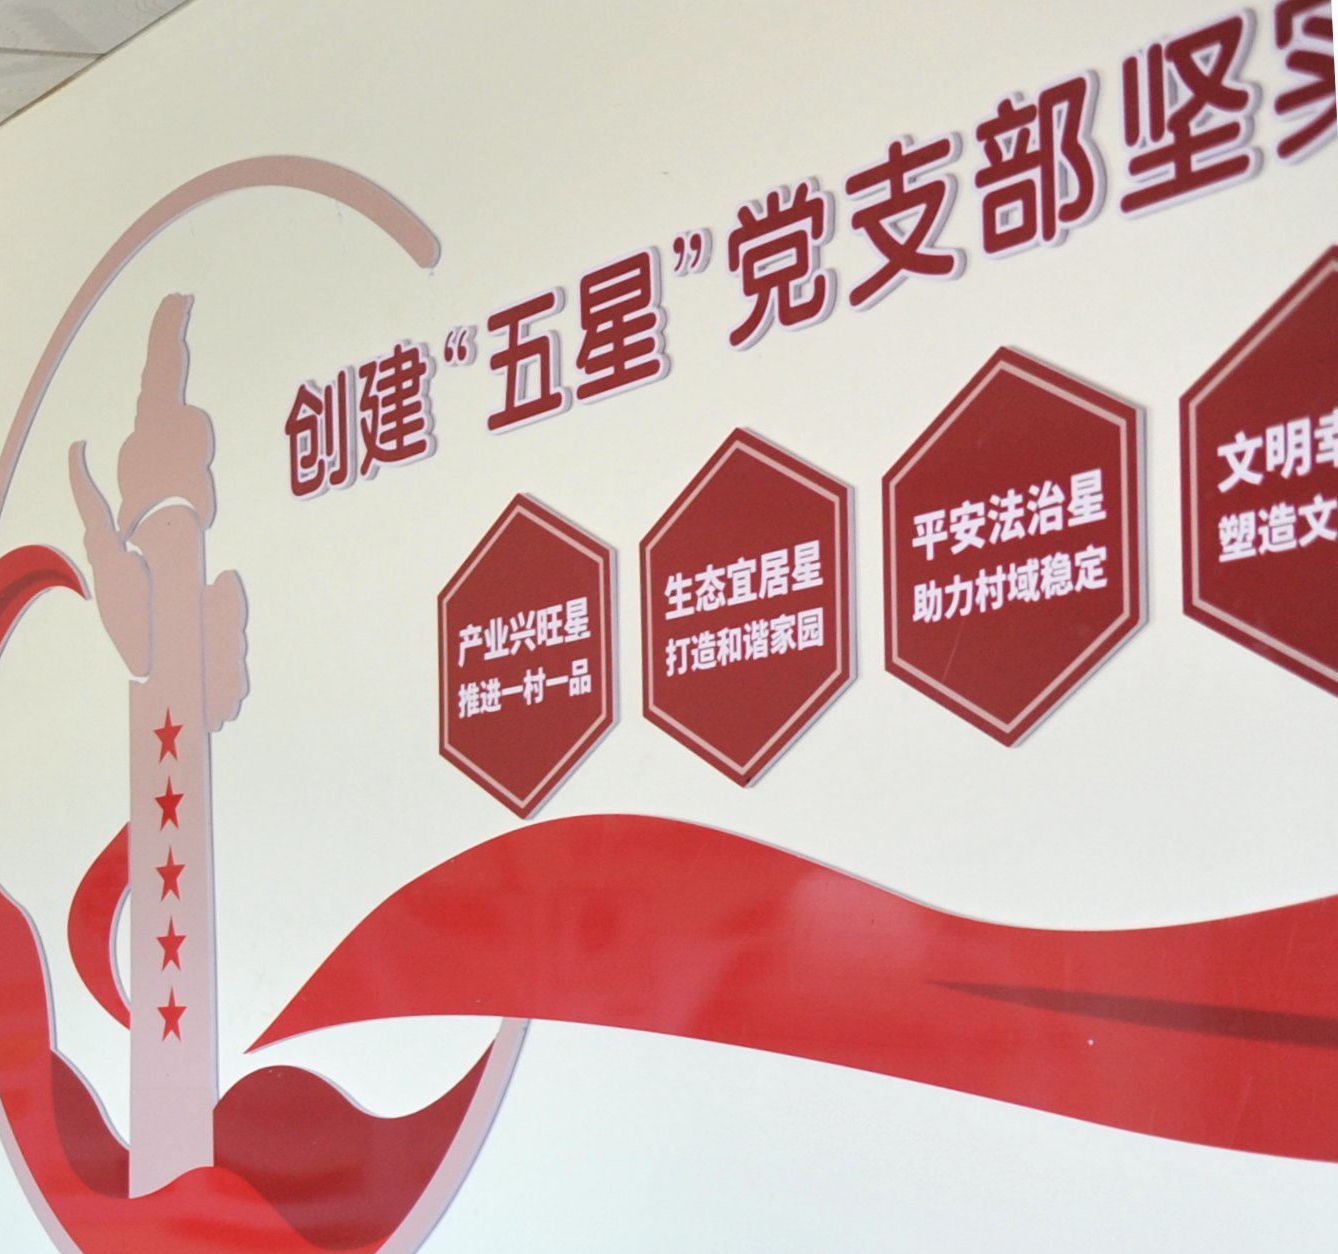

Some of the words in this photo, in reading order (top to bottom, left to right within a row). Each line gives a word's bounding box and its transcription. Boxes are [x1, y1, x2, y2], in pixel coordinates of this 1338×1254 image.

[912, 468, 1107, 561] 平安法治星
[1218, 494, 1338, 563] 塑造文
[665, 540, 823, 620] 生态宜居星
[912, 544, 1107, 624] 助力村域稳定
[458, 597, 590, 668] 产业兴旺星
[665, 607, 824, 677] 打造和谐家园
[458, 658, 592, 719] 推进一村一品
